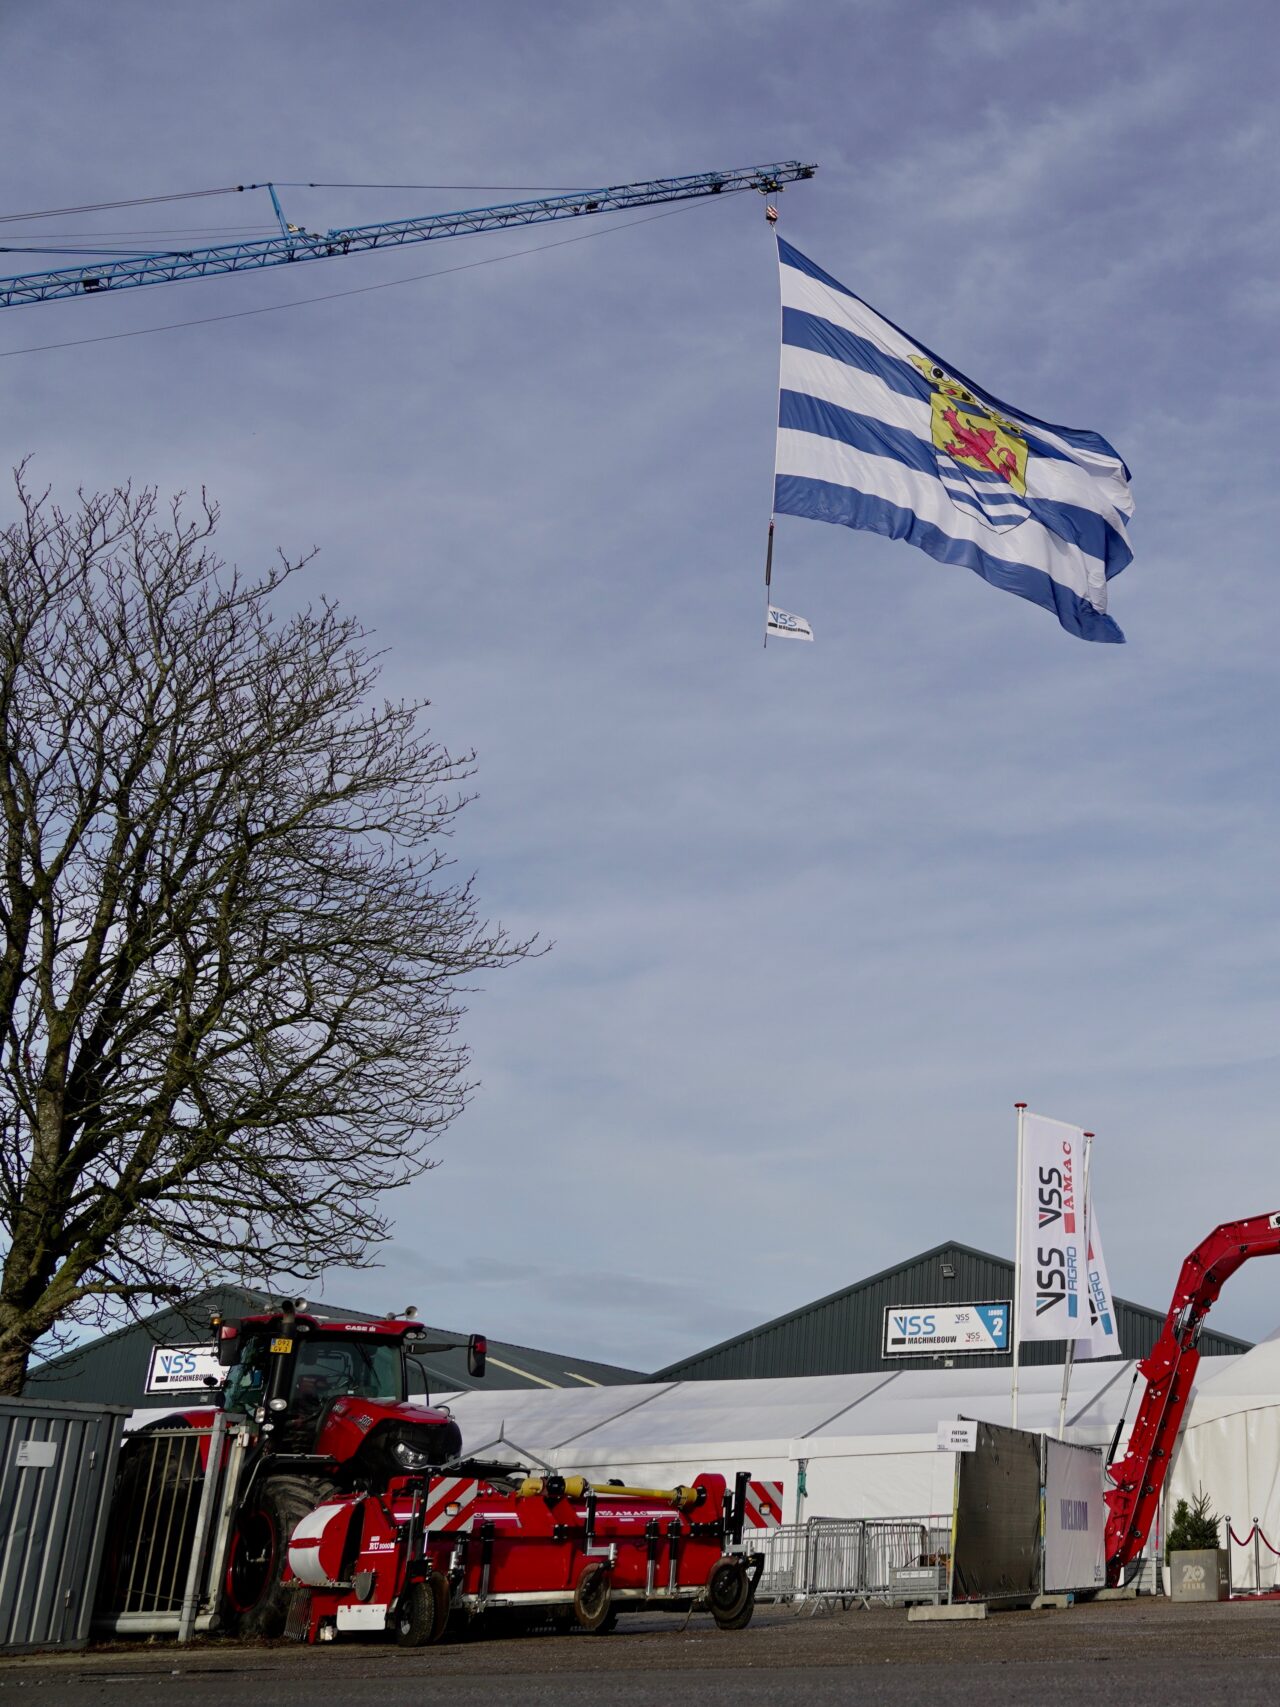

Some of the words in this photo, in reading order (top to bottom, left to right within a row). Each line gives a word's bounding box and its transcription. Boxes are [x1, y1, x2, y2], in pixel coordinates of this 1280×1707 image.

[769, 610, 797, 627] VSS
[1062, 1141, 1075, 1210] AMAC
[1038, 1166, 1062, 1229] VSS
[1066, 1246, 1077, 1291] AGRO
[1036, 1247, 1066, 1317] VSS
[1089, 1271, 1108, 1312] AGRO
[894, 1315, 936, 1336] VSS
[955, 1313, 970, 1321] VSS
[992, 1317, 1003, 1336] 2
[907, 1336, 957, 1345] MACHINEBOUW
[966, 1332, 981, 1340] VSS
[160, 1354, 197, 1374] VSS
[1061, 1499, 1088, 1531] WELKOM
[369, 1542, 380, 1550] RU
[1182, 1564, 1205, 1583] 20
